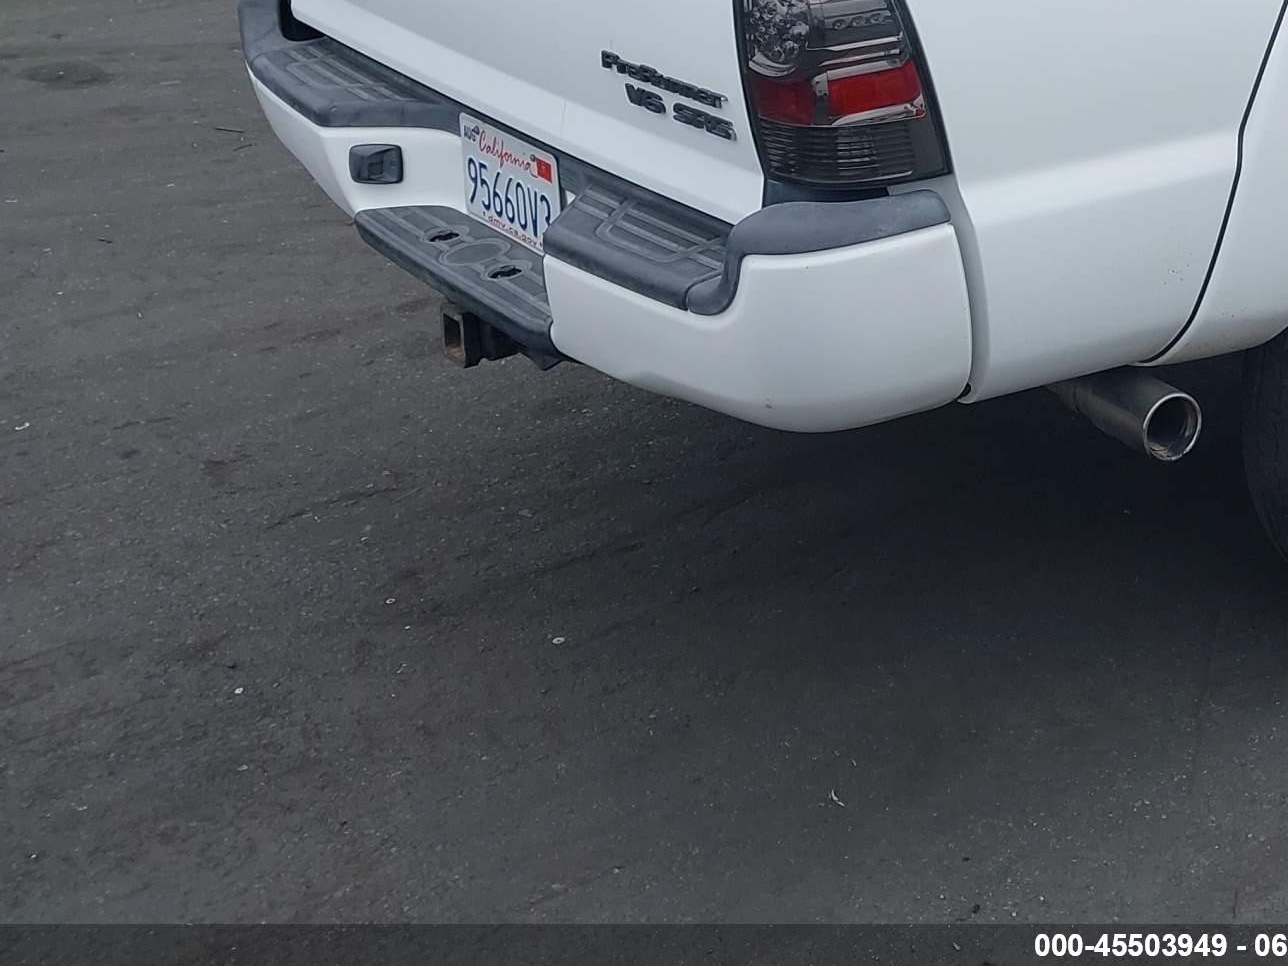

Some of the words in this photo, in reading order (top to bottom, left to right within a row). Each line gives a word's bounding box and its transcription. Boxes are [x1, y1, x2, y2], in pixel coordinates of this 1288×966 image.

[625, 83, 666, 114] V6
[673, 102, 737, 141] SR5
[479, 130, 532, 170] California
